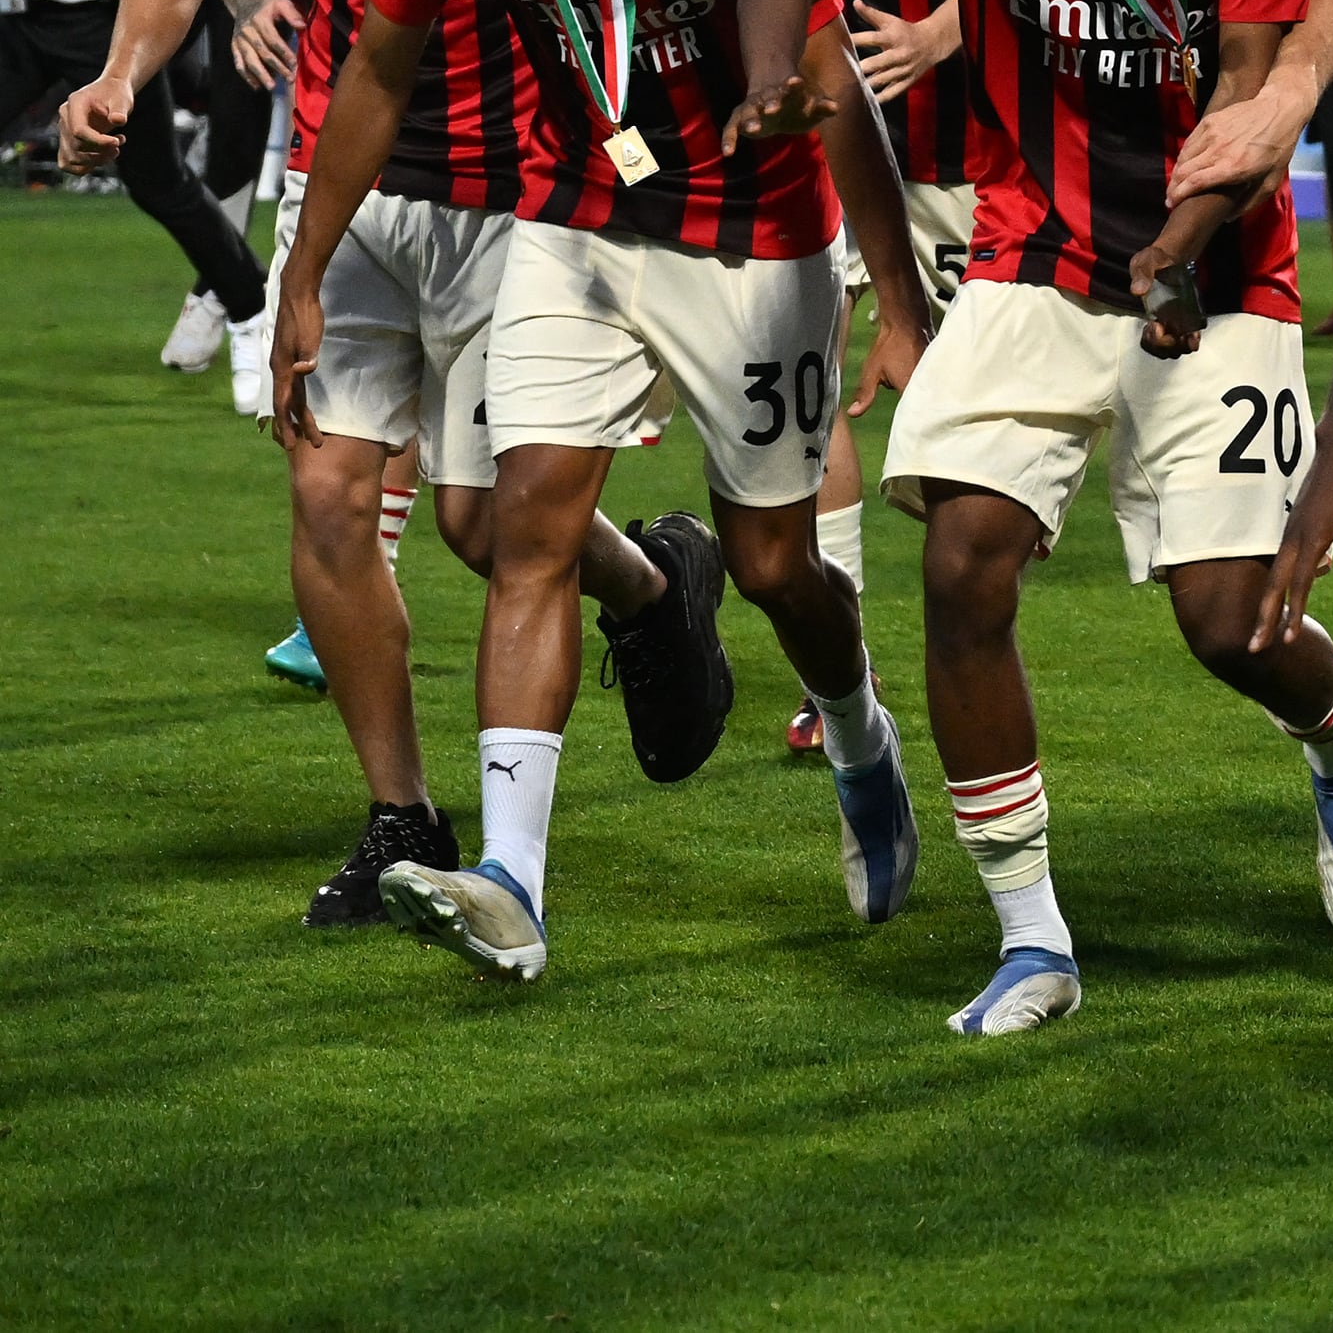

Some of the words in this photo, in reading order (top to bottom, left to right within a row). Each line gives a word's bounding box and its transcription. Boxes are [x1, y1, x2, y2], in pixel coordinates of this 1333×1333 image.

[629, 27, 702, 74] TTER
[1043, 37, 1086, 79] FLY
[1098, 46, 1204, 88] BETTER
[742, 351, 825, 446] 30
[1219, 385, 1302, 477] 20
